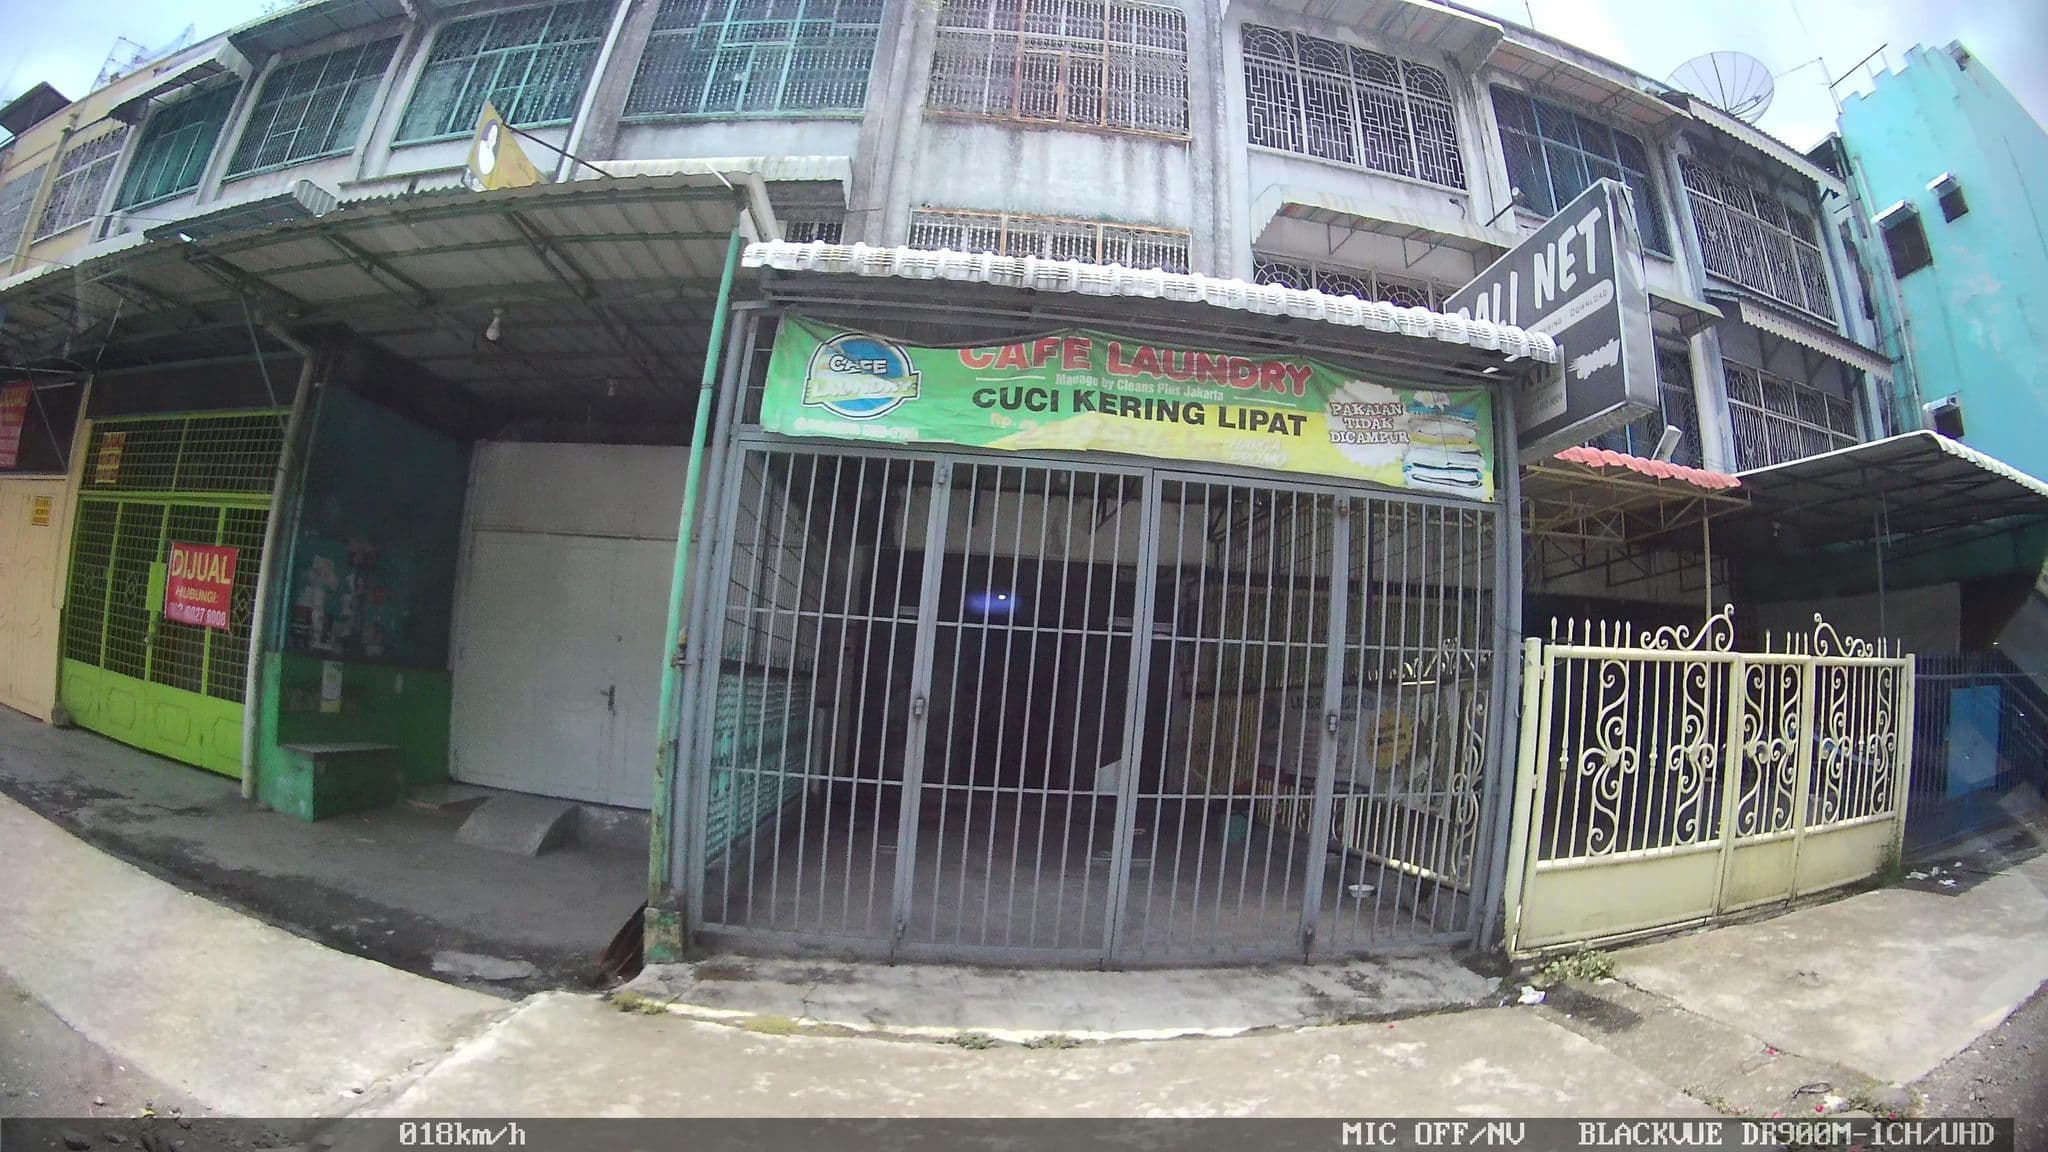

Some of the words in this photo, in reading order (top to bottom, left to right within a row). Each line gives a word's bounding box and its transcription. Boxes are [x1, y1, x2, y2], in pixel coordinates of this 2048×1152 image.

[1534, 207, 1601, 309] NET
[1569, 288, 1609, 317] DOWNLOAD
[829, 354, 888, 375] CAFE
[958, 336, 1092, 371] CAFE
[1106, 341, 1313, 397] LAUNDRY
[1055, 373, 1098, 387] Manage
[1101, 377, 1114, 391] by
[1117, 379, 1154, 394] Cleans
[1157, 382, 1181, 396] Plus
[1183, 385, 1224, 401] Jakarta
[972, 386, 1059, 413] CUCI
[1073, 389, 1205, 426] KERING
[1218, 405, 1308, 437] LIPAT
[1329, 402, 1403, 416] PAKAIAN
[1342, 416, 1394, 430] TIDAK
[1329, 430, 1411, 444] DICAMPUR
[172, 548, 230, 584] DIJUAL
